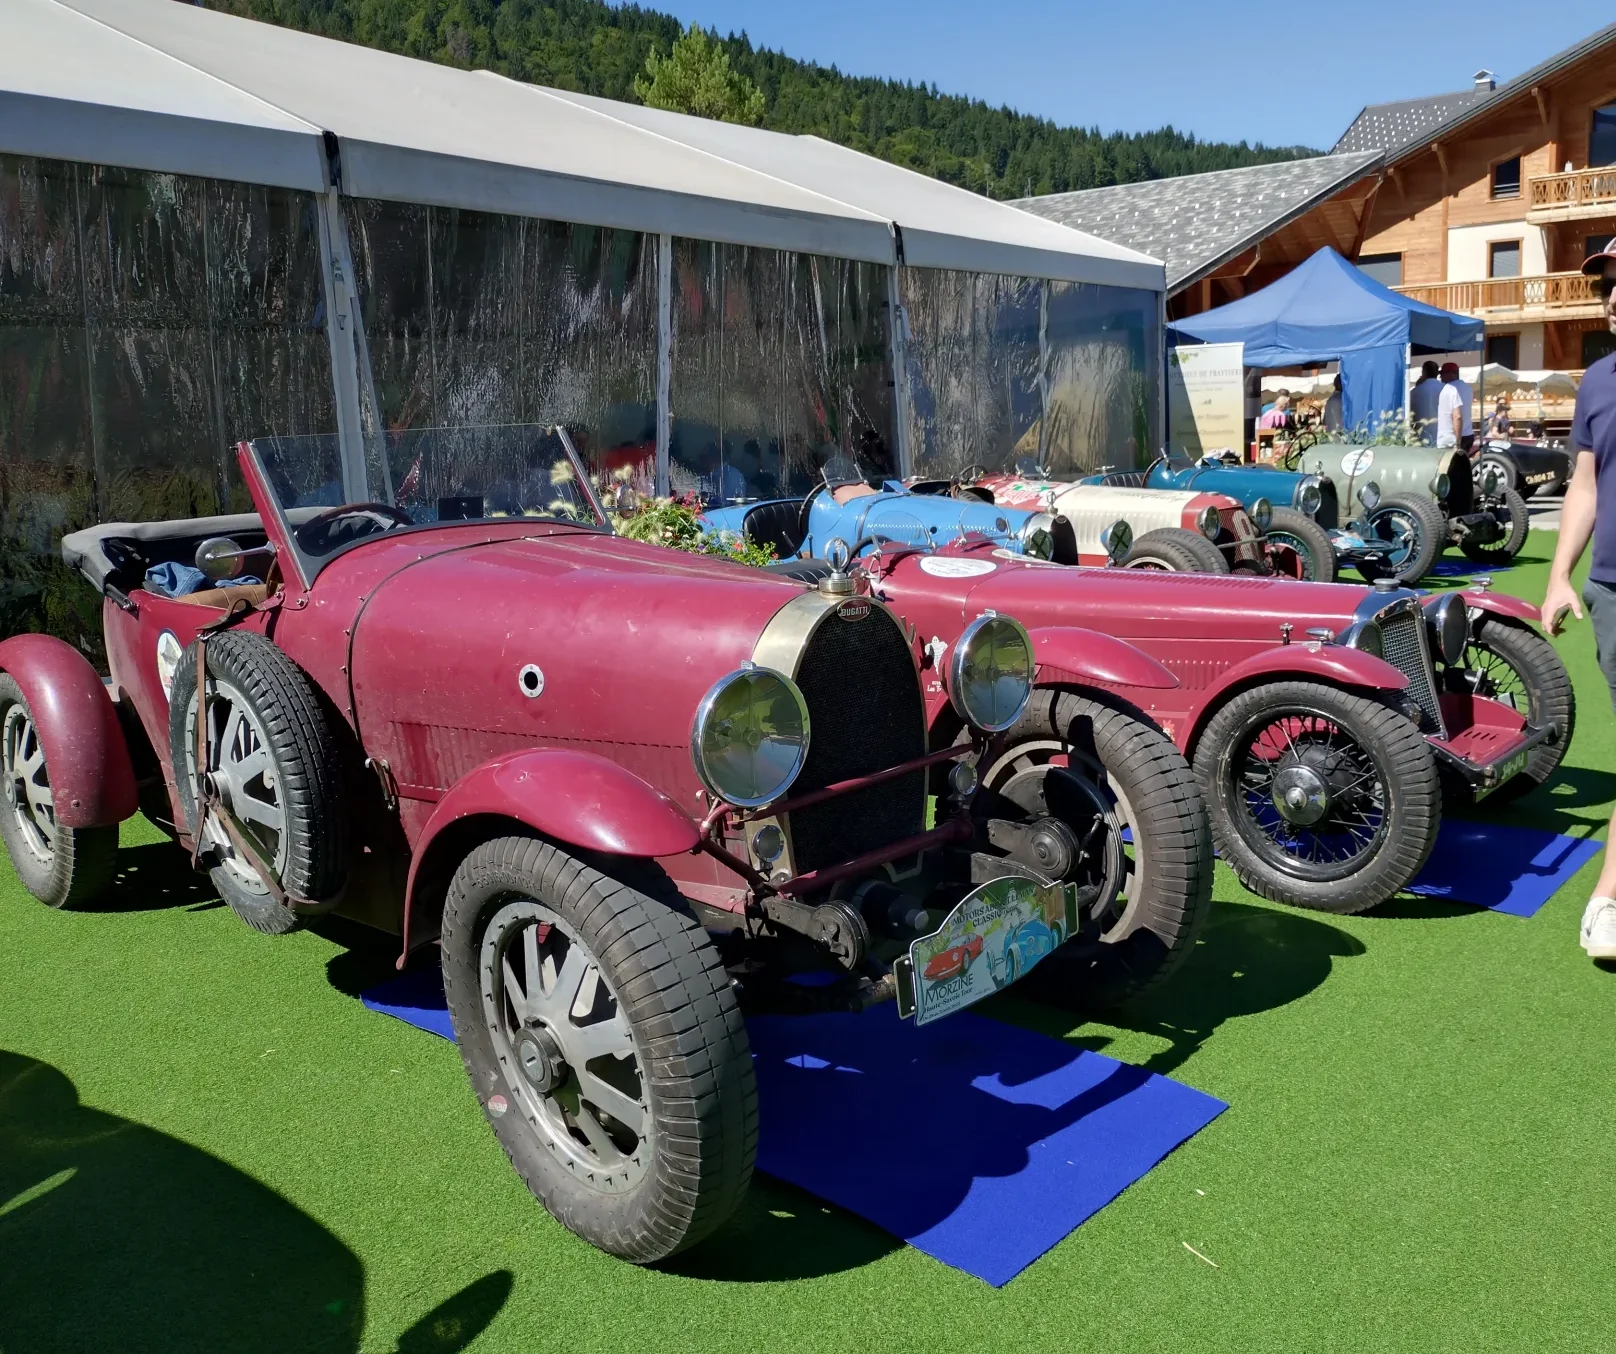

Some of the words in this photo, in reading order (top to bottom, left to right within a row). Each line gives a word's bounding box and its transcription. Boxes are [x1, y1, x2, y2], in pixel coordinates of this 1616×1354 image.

[841, 606, 868, 617] BUGATTI
[972, 907, 1001, 928] CLASSIC
[925, 973, 974, 1006] MORZINE
